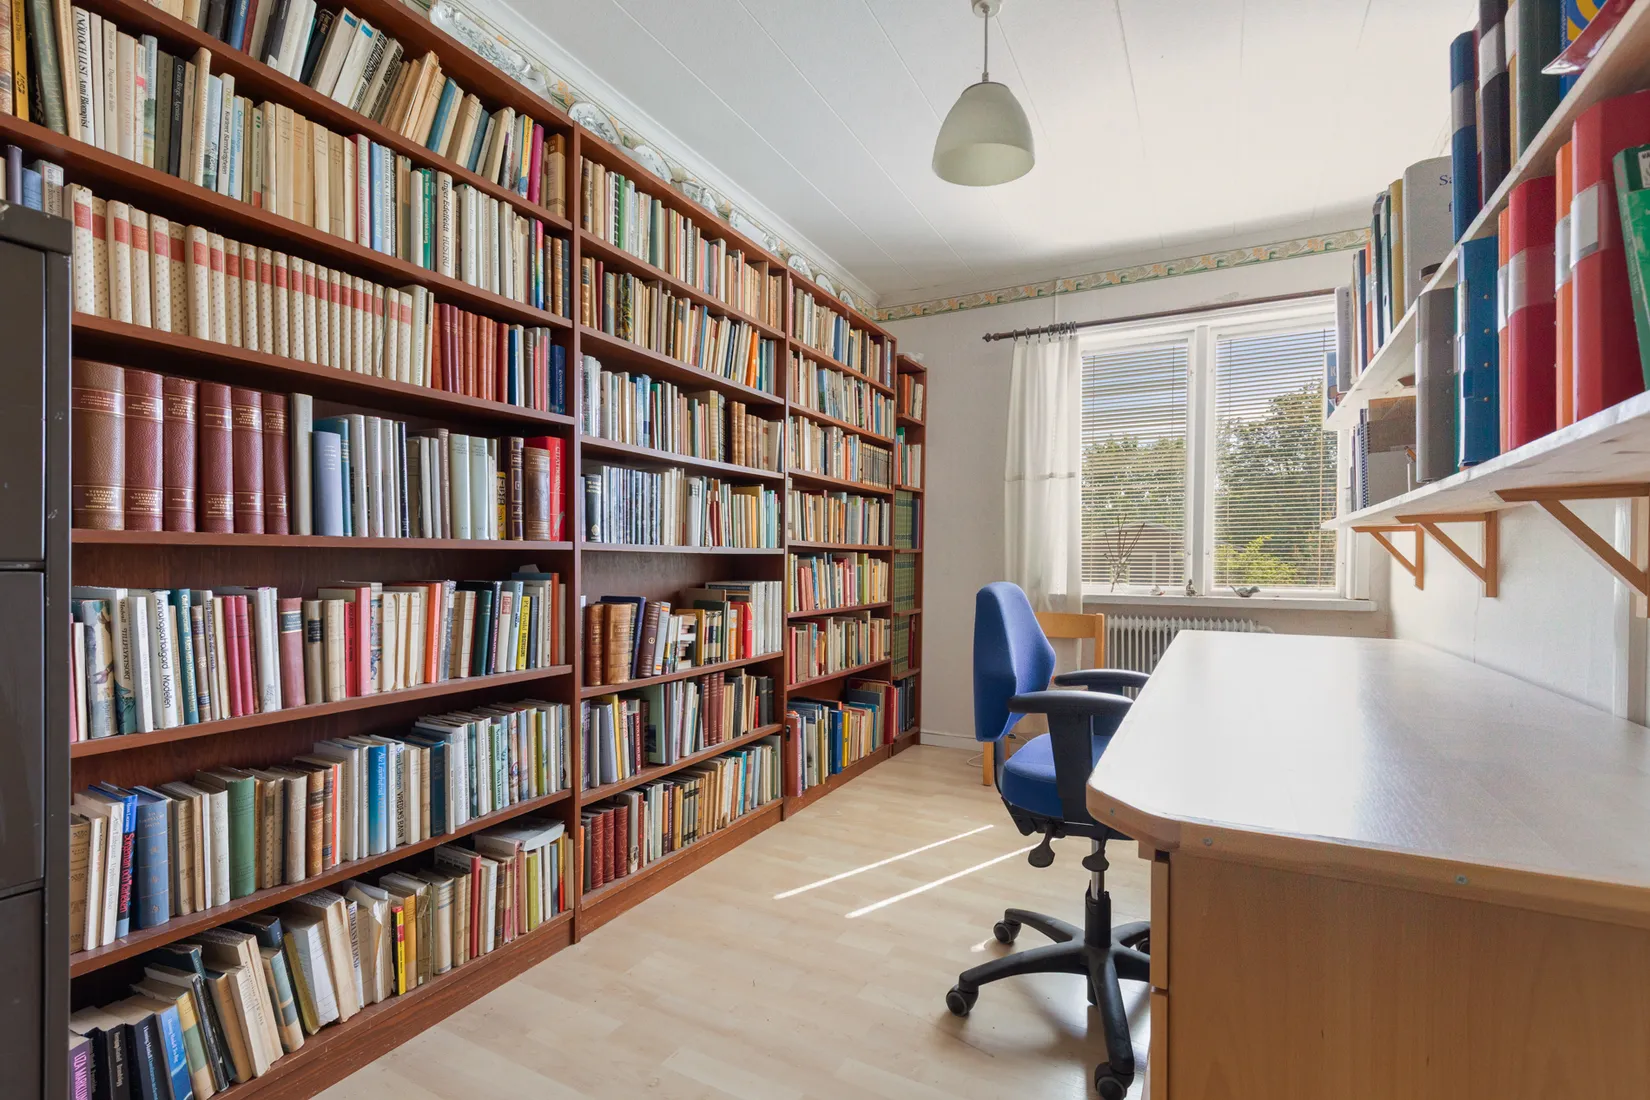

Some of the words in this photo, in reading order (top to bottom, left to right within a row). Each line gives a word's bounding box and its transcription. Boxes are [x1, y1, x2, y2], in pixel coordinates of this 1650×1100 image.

[76, 14, 89, 33] NÖD
[77, 34, 88, 54] OCH
[78, 54, 89, 77] LUST
[175, 64, 184, 81] Göran
[363, 43, 384, 86] BALDERSON
[383, 54, 401, 85] BALDERSON
[79, 78, 89, 96] Anni
[174, 80, 183, 97] Börge
[78, 95, 90, 129] Blomqvist
[174, 98, 182, 121] Agenten
[223, 110, 231, 133] Kvarteret
[221, 133, 230, 175] Barmhärtigheten
[442, 179, 450, 199] Inger
[442, 199, 450, 232] Edelfeldt
[442, 235, 450, 268] HUSTRU
[554, 446, 562, 491] CITATBOKEN
[119, 599, 127, 623] Hedvall
[182, 604, 190, 633] Lagercrantz
[521, 611, 529, 631] Jersild
[121, 627, 131, 681] TILLFLYKTSORT
[184, 635, 192, 651] FÄRD
[185, 650, 193, 663] MED
[186, 663, 195, 692] MÖRKRETS
[161, 673, 172, 709] Modellen
[396, 747, 404, 764] Sara
[396, 763, 404, 789] Lidman
[396, 791, 405, 820] VREDENS
[121, 833, 135, 868] Sorgeman
[121, 868, 132, 880] och
[113, 1031, 122, 1048] Henning
[143, 1025, 152, 1043] Henning
[73, 1051, 87, 1070] LIZA
[115, 1047, 123, 1062] Mankell
[144, 1042, 153, 1059] Mankell
[115, 1063, 124, 1087] Brandvägg
